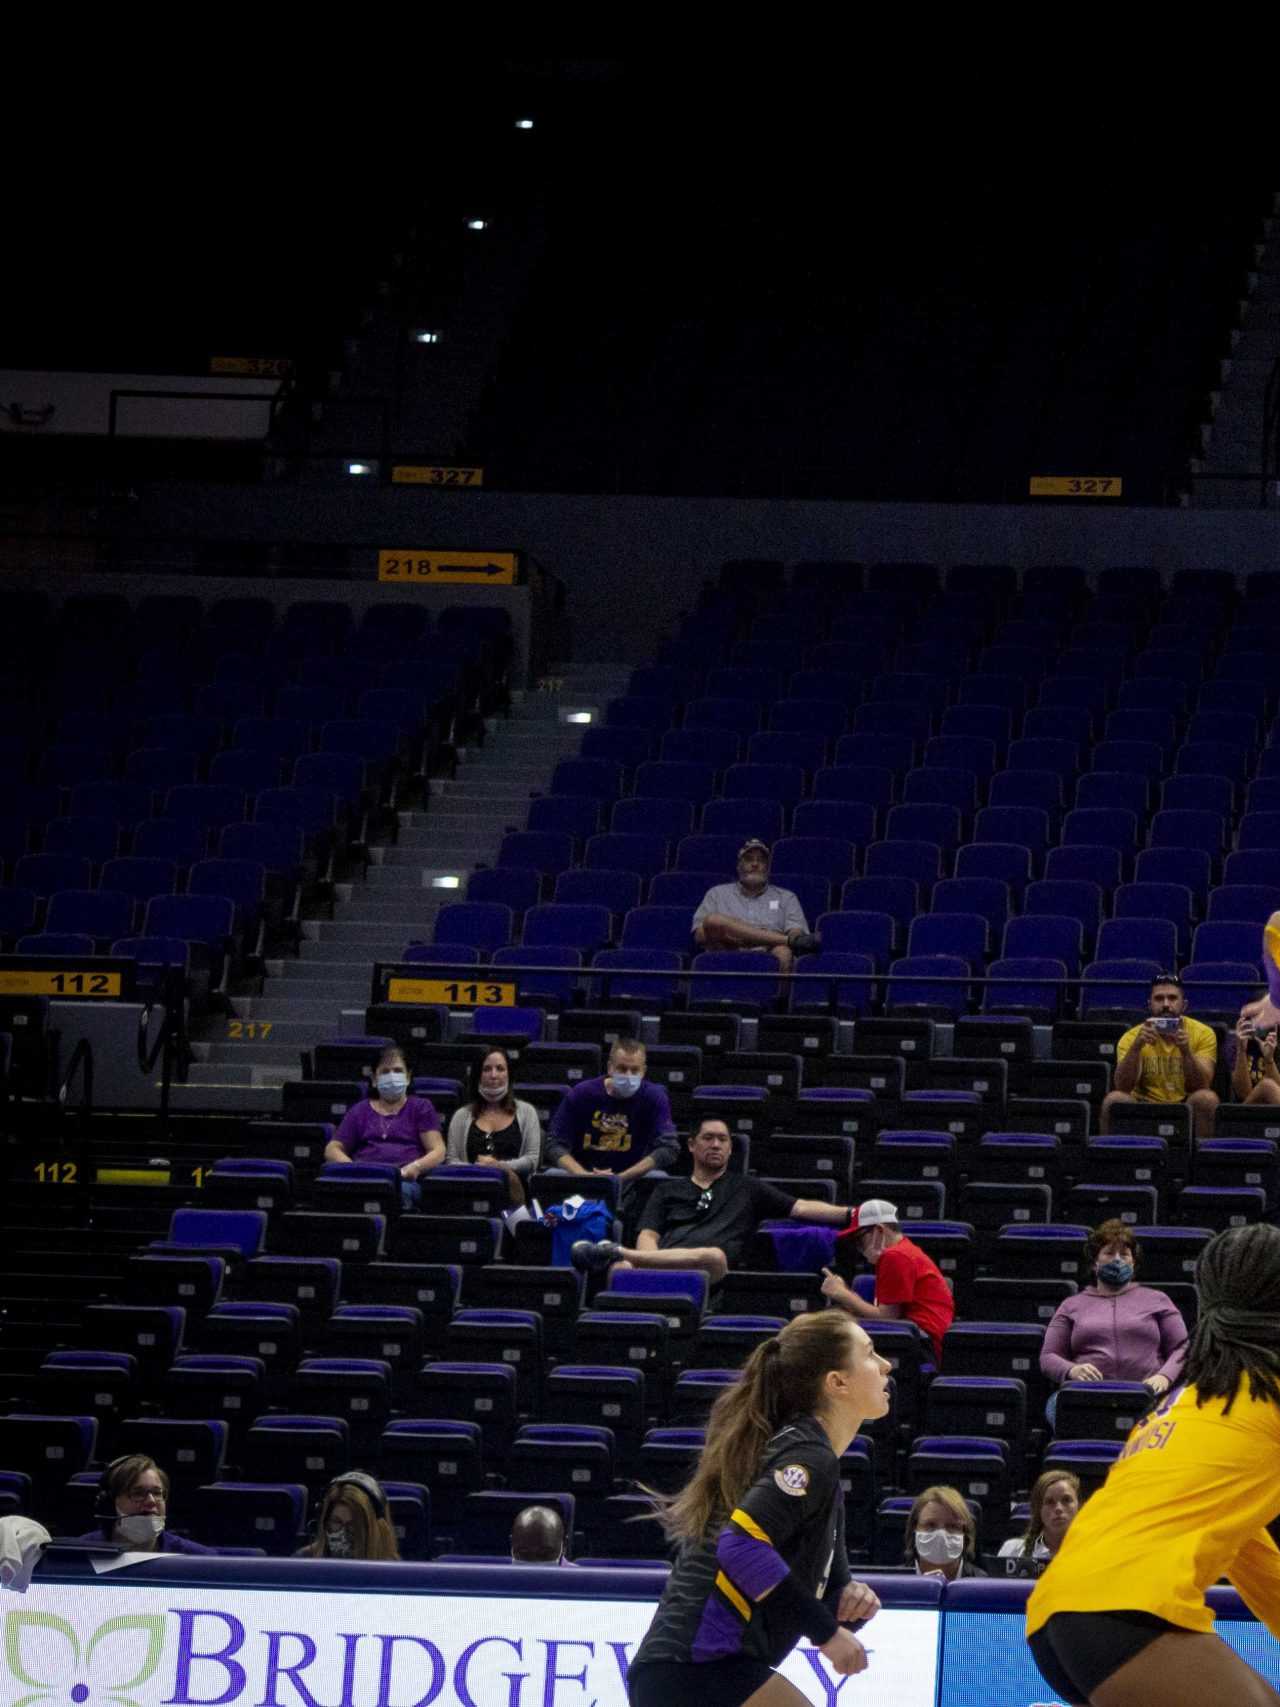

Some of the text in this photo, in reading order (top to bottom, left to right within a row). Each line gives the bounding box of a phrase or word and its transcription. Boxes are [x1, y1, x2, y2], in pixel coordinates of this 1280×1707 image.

[431, 466, 475, 483] 327
[1068, 479, 1114, 494] 327
[385, 559, 432, 576] 218
[50, 975, 109, 993] 112
[444, 984, 503, 1004] 113
[227, 1021, 272, 1040] 217
[33, 1162, 78, 1184] 112
[160, 1608, 875, 1707] BRIDGEY
